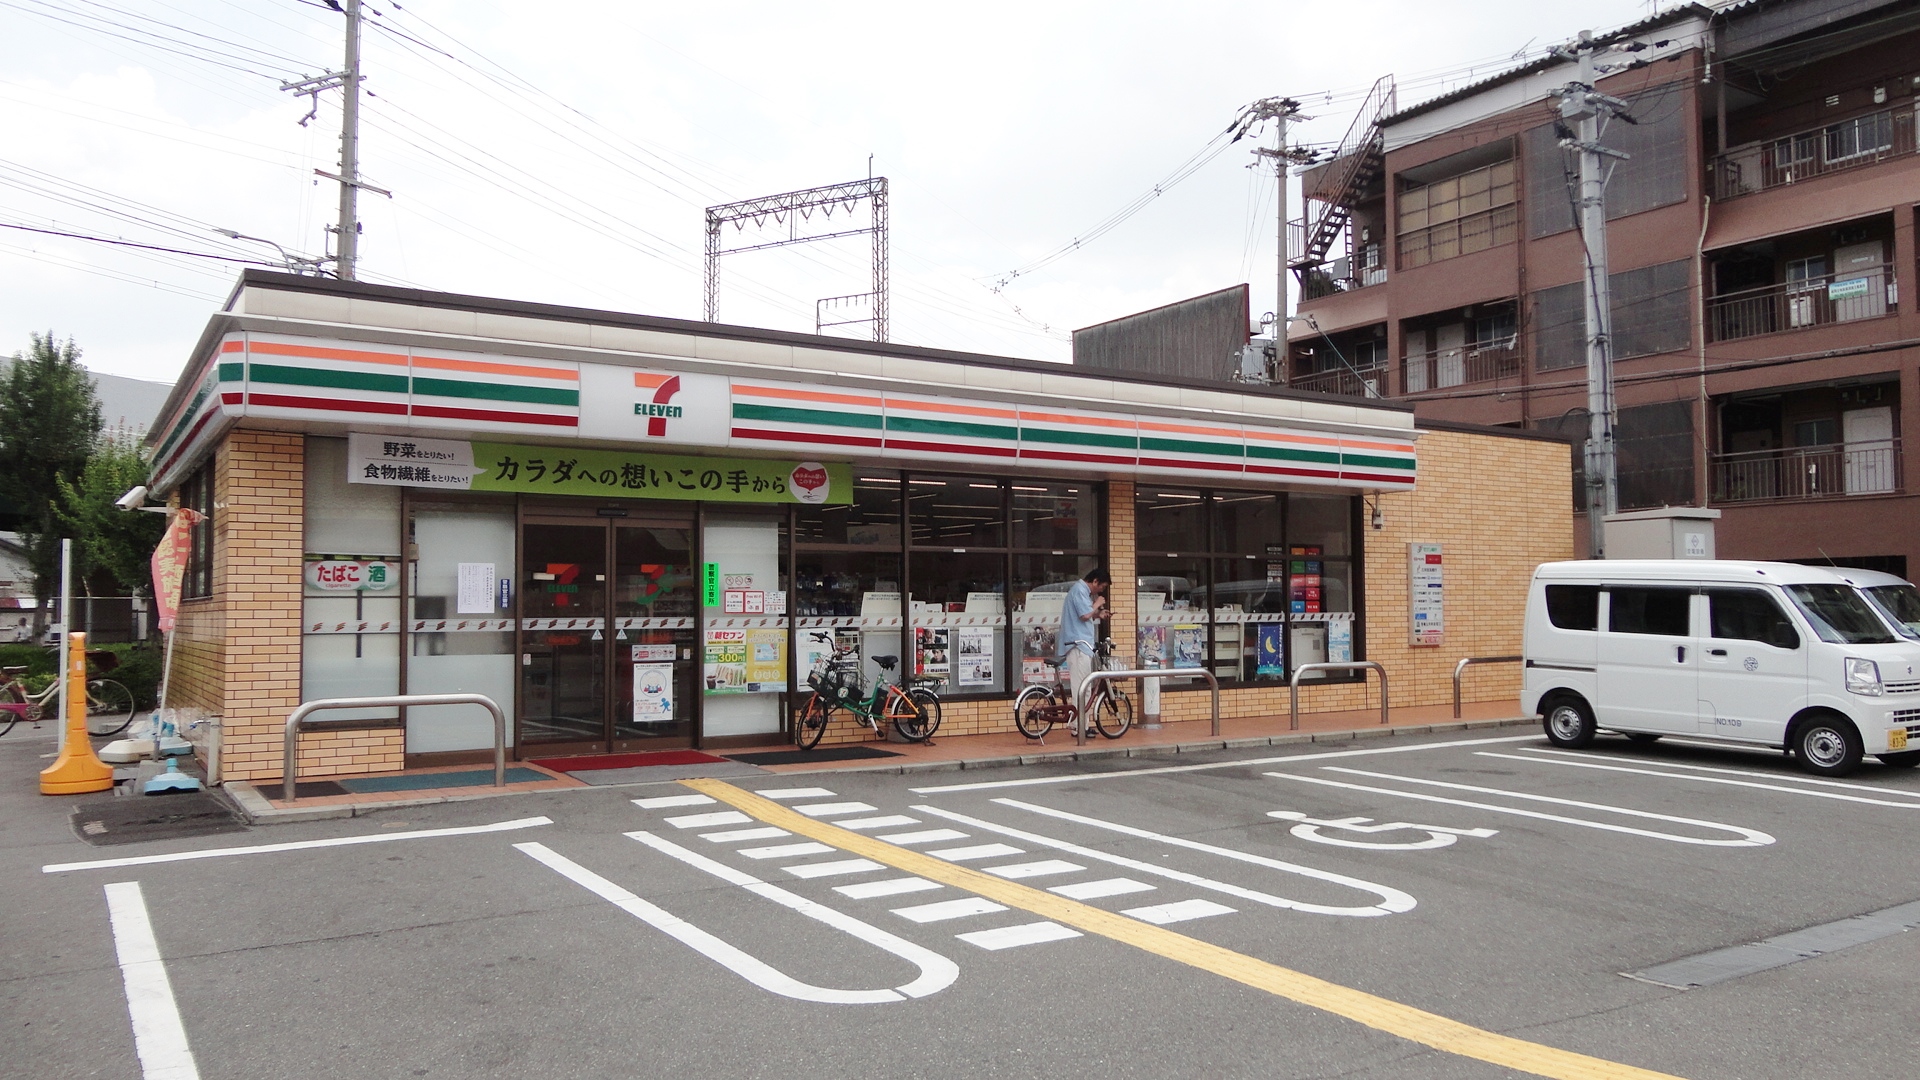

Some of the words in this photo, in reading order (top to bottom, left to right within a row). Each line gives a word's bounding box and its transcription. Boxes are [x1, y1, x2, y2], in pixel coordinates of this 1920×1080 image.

[634, 372, 681, 437] 7
[494, 456, 786, 494] カラダへの想いこの手から
[317, 565, 360, 583] たばこ
[368, 565, 386, 582] 酒
[714, 631, 744, 640] 朝セブン
